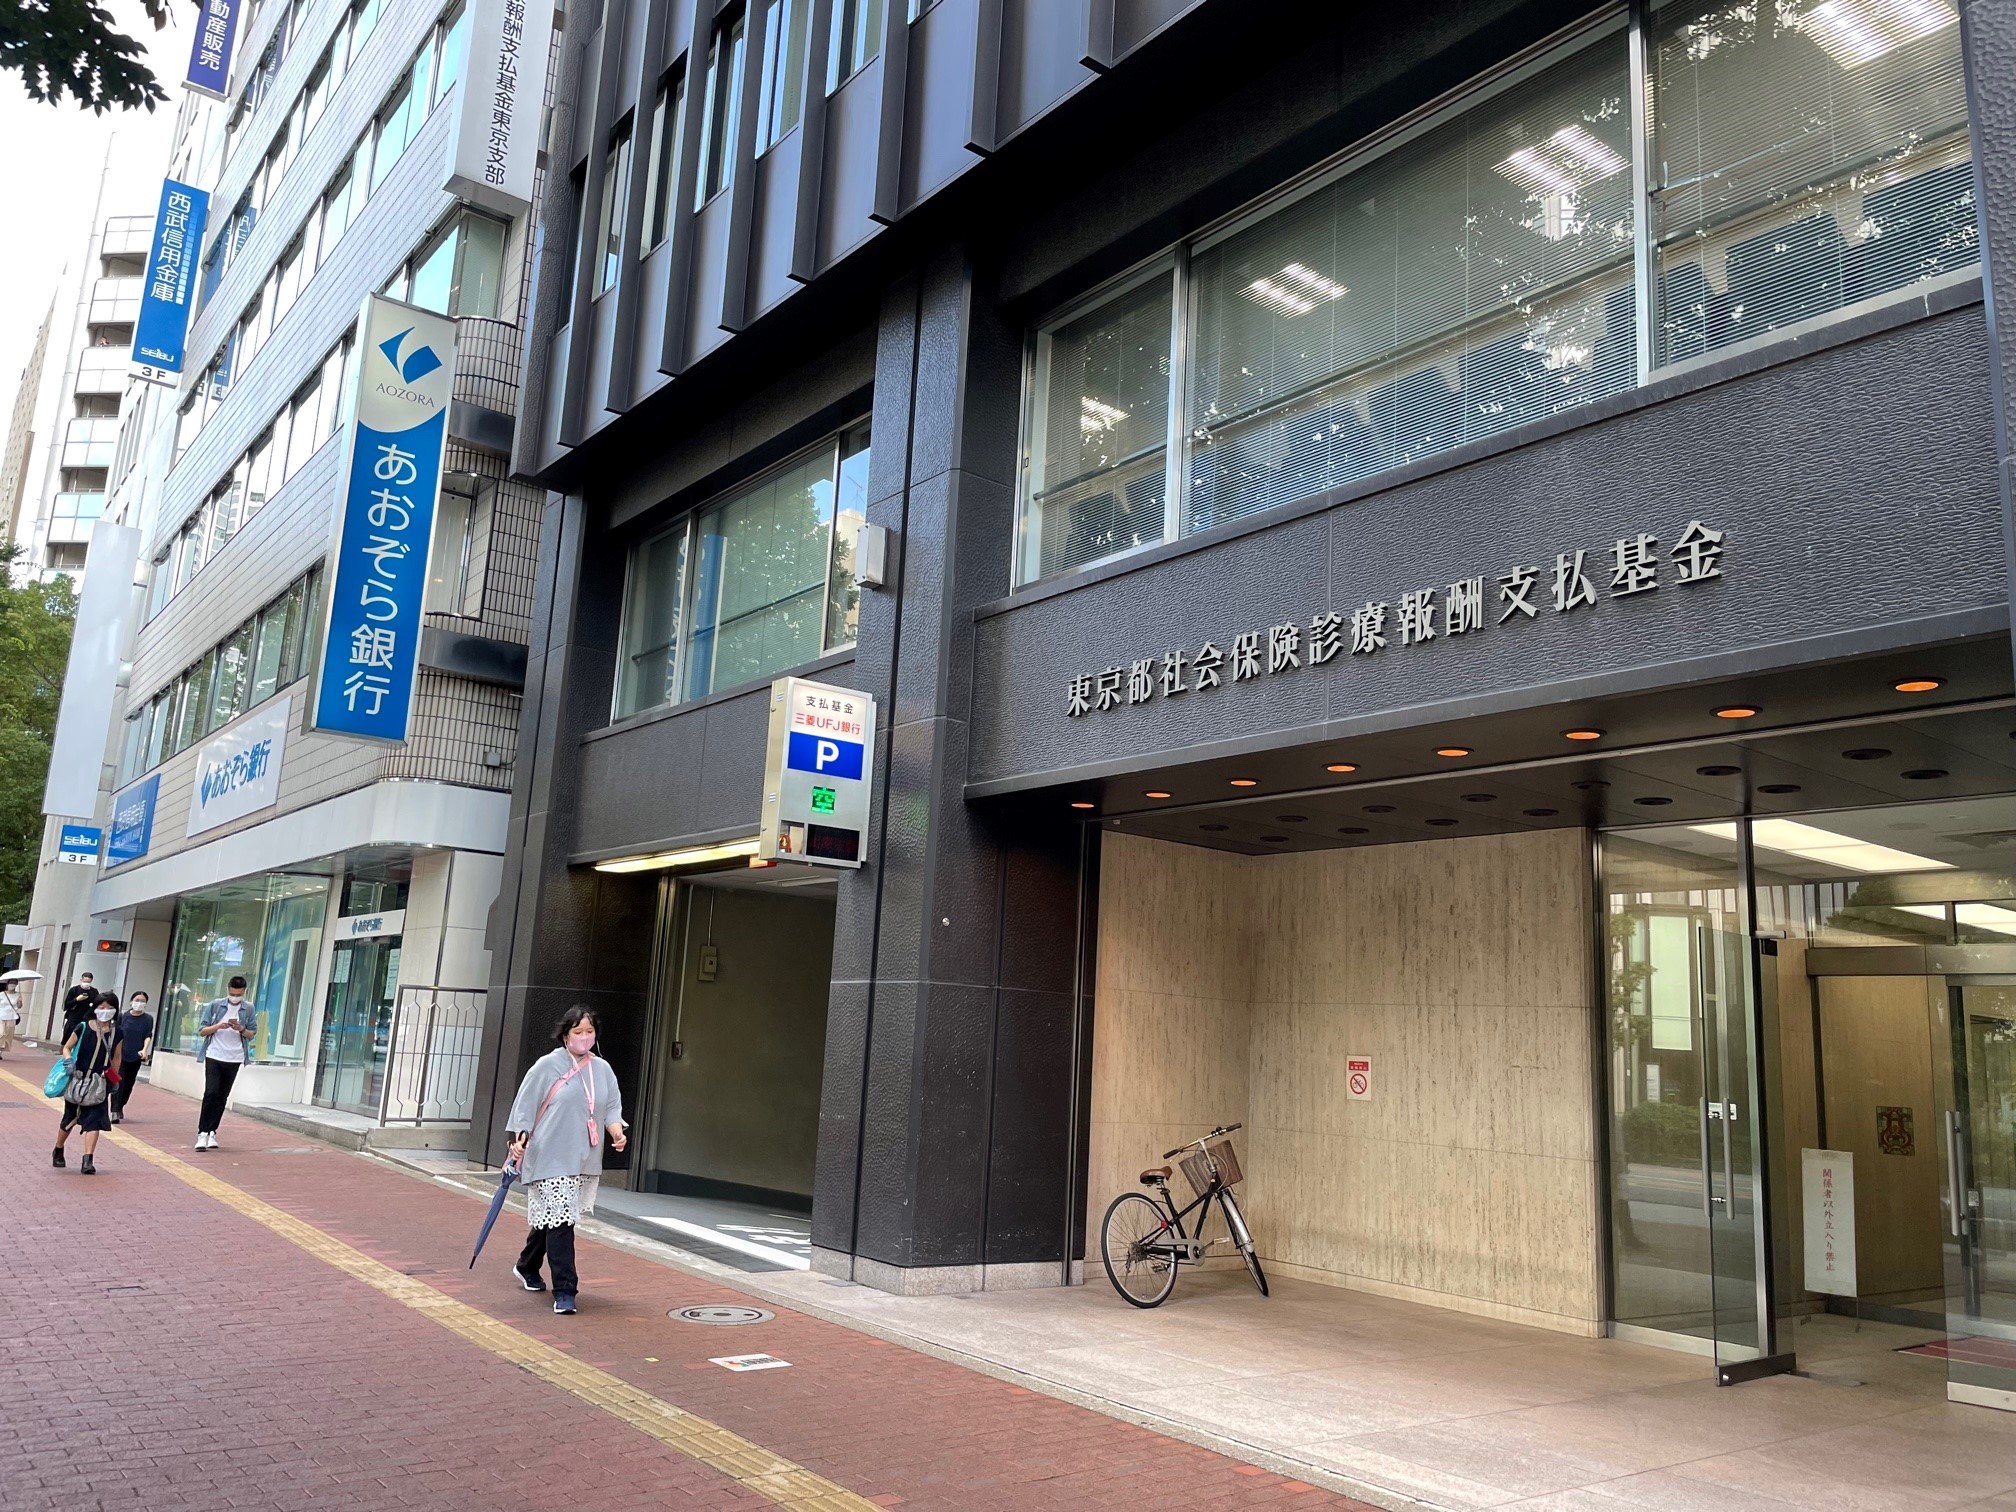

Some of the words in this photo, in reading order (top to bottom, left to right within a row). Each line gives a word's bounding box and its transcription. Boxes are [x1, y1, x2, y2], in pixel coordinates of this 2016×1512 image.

[485, 0, 527, 186] 報酬支払基金東京支部
[150, 190, 192, 303] 西武信用金庫
[376, 381, 435, 408] AOZORA
[343, 442, 417, 716] あおぞら銀行
[1066, 520, 1725, 717] 東京都社会保険診療報酬支払基金
[795, 712, 861, 736] 三菱UFJ銀行
[806, 695, 854, 715] 支払基金
[815, 739, 840, 771] P
[1822, 1168, 1835, 1272] 関係者以外立入り禁止
